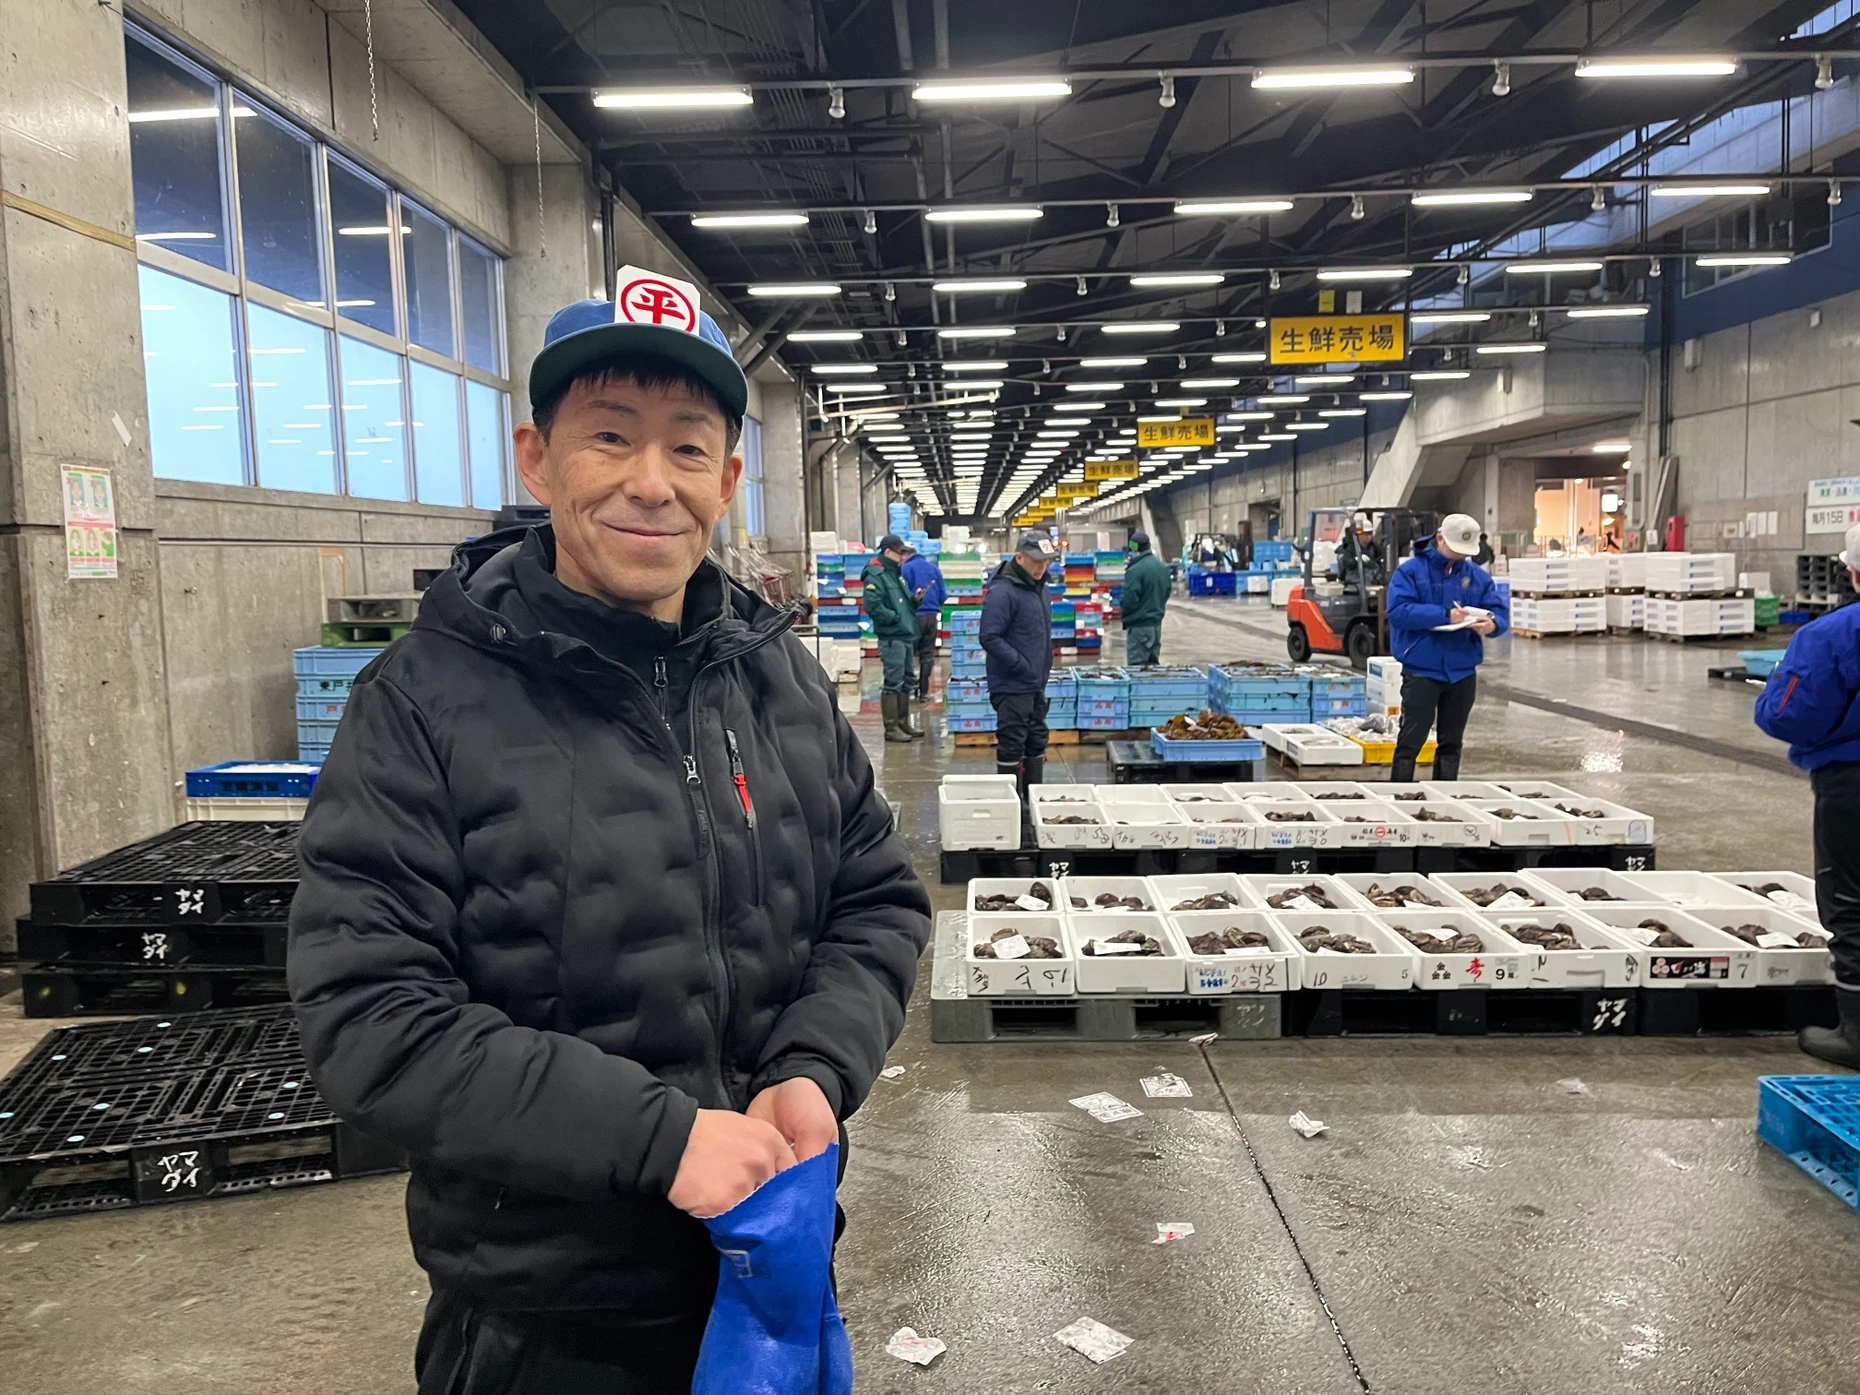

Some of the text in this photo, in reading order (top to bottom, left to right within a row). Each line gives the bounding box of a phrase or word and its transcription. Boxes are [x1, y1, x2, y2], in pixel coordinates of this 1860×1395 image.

[631, 286, 686, 325] 平
[1280, 324, 1394, 354] 生鮮売場
[1143, 424, 1209, 441] 生鮮売場
[1088, 465, 1135, 477] 生鮮売場
[1495, 968, 1505, 980] 9
[1737, 963, 1748, 979] 7
[157, 1150, 200, 1173] ヤマ
